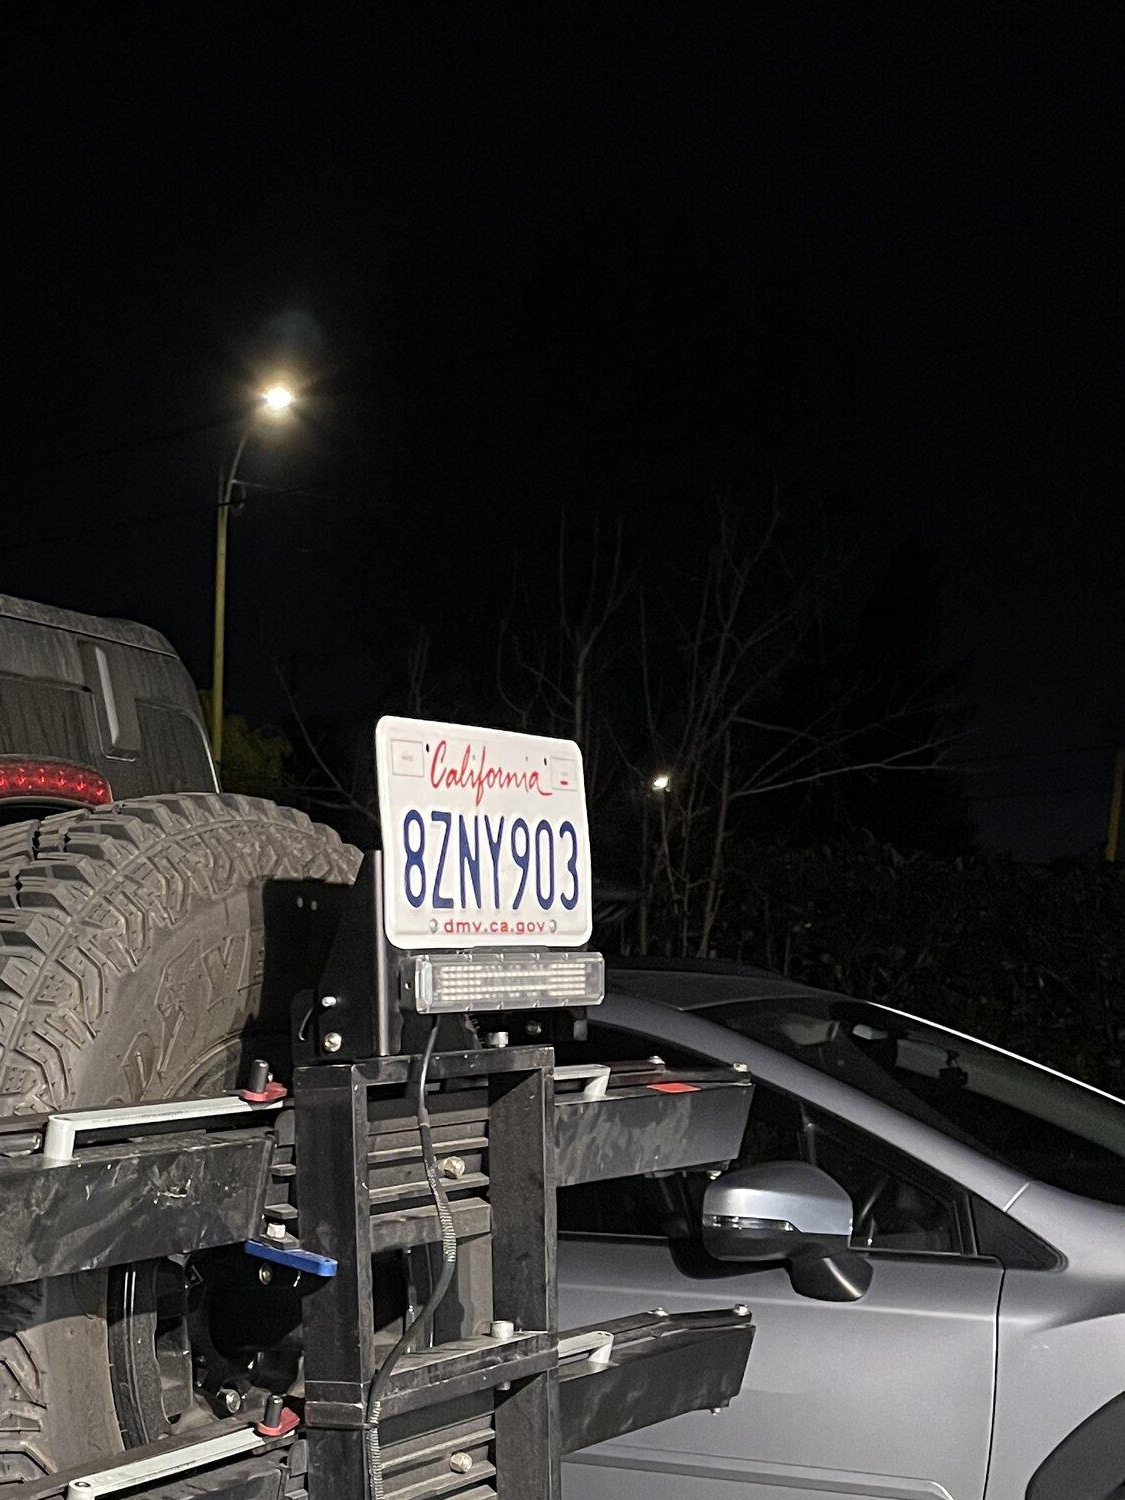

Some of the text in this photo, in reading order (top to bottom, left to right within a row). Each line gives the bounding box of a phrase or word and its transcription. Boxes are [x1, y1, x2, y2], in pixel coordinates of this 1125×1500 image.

[430, 740, 553, 807] California
[403, 809, 579, 910] 8ZNY903
[444, 918, 545, 935] dmv.ca.gov
